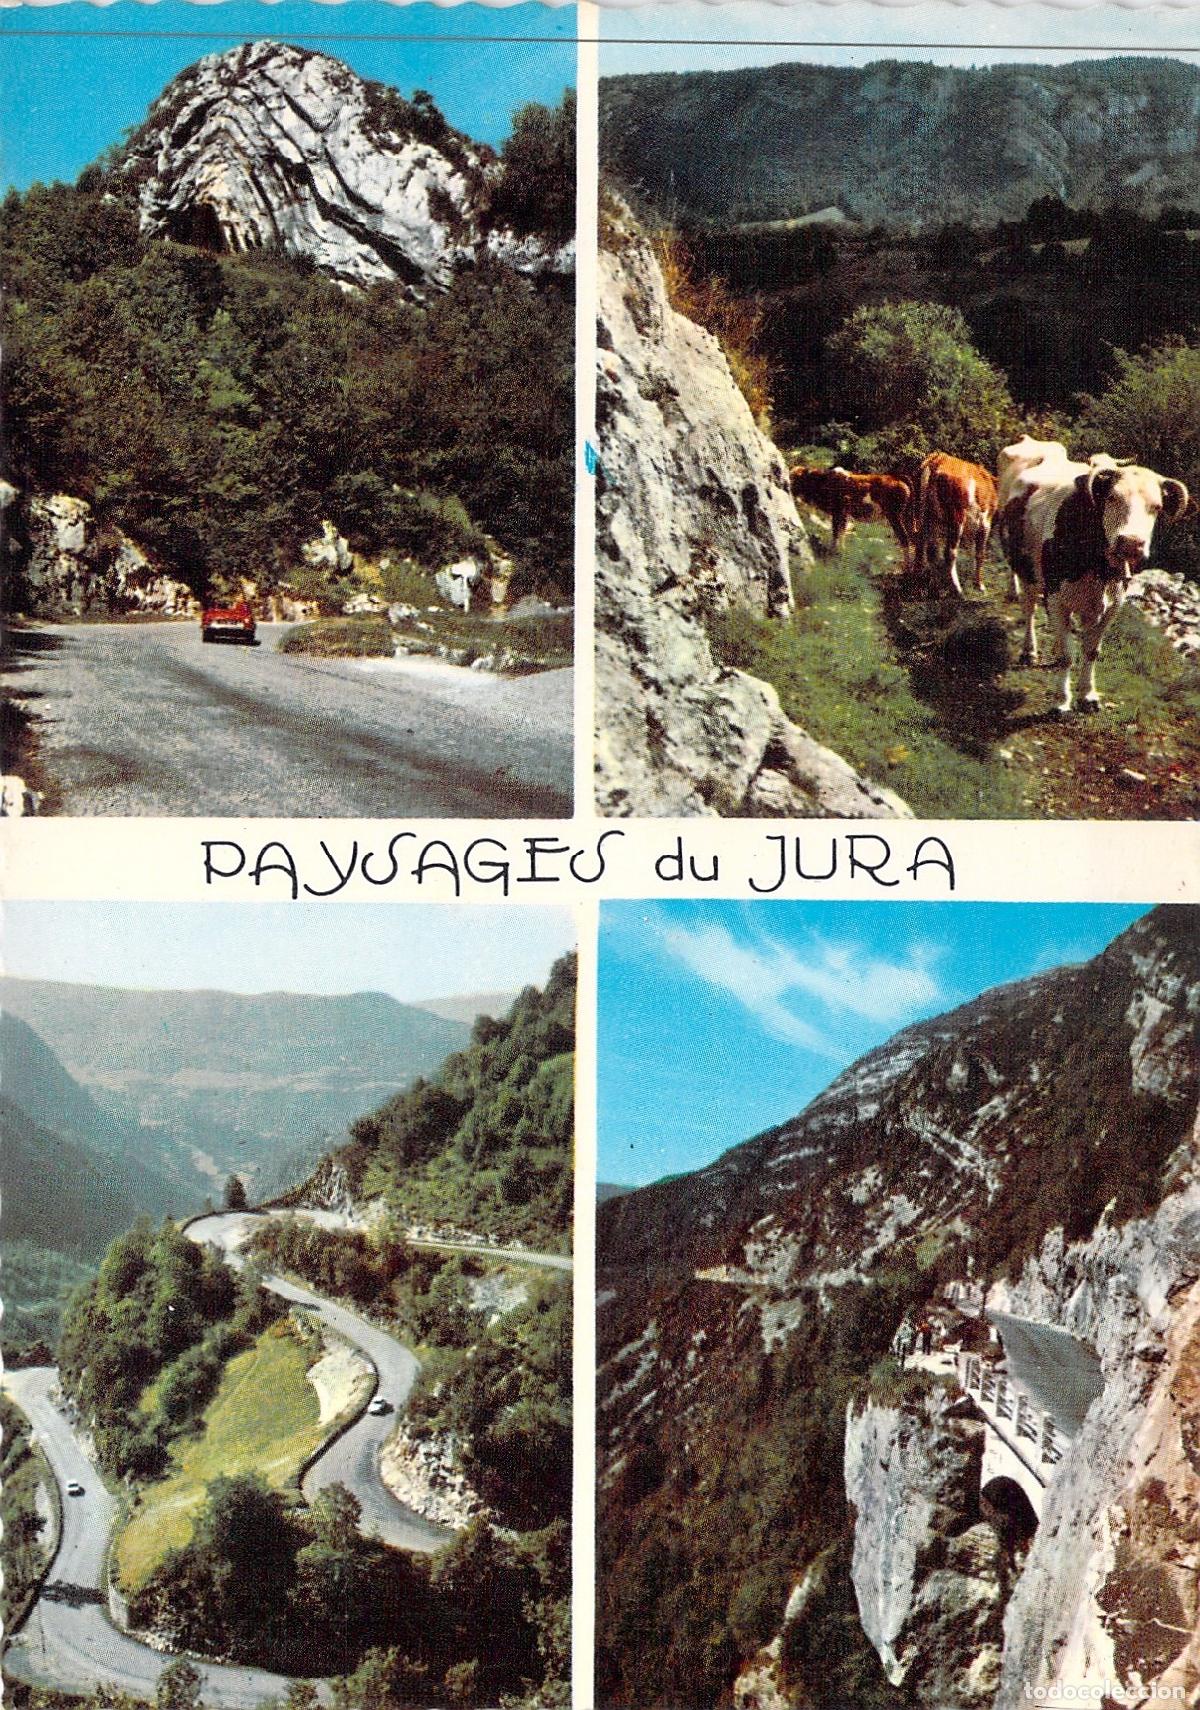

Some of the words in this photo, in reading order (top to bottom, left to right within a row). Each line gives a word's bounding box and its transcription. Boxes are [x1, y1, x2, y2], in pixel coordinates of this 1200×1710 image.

[200, 830, 624, 899] PAYSAGES
[654, 836, 718, 882] du
[748, 834, 954, 892] JURA
